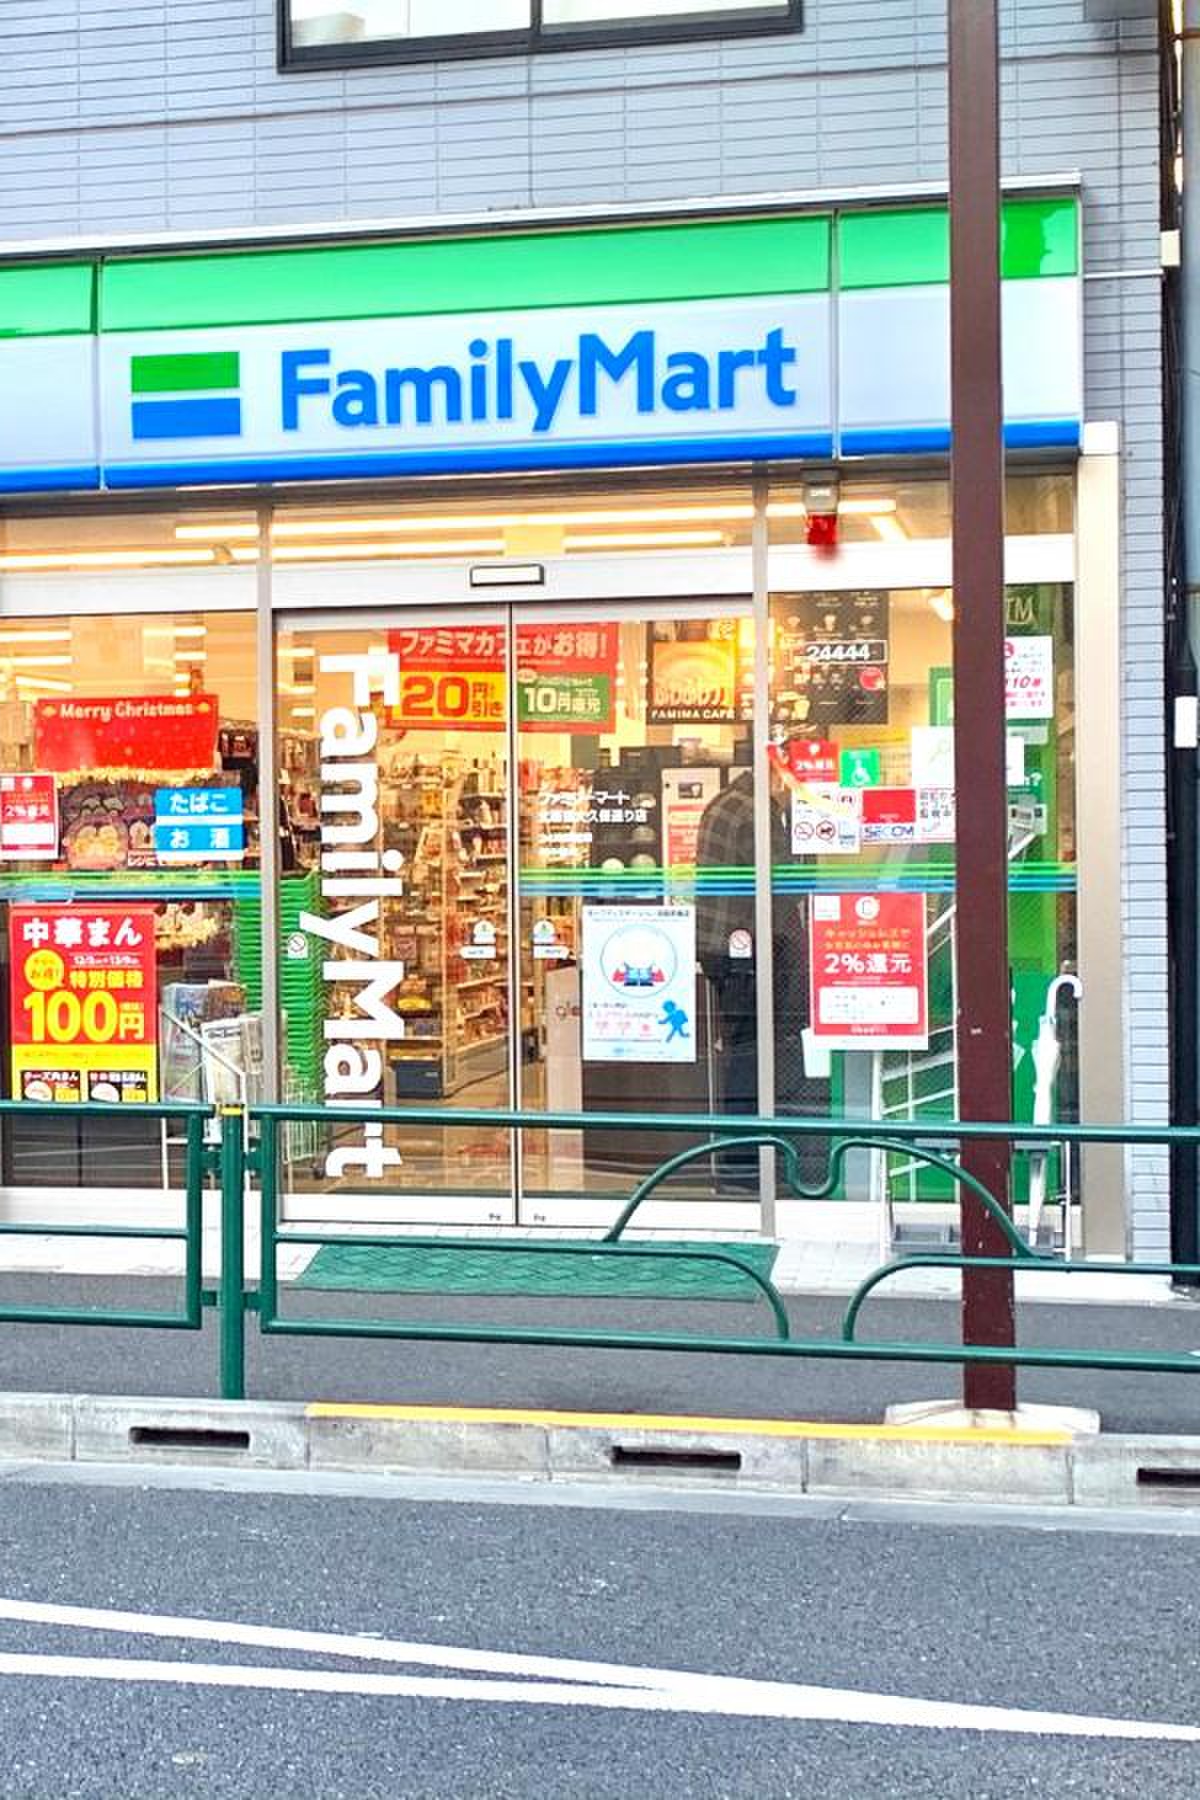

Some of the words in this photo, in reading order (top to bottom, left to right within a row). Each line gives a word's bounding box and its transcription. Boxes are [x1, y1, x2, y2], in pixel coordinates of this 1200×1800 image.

[281, 327, 797, 432] FamilyMart
[402, 676, 469, 717] 20
[61, 703, 112, 723] Merry
[115, 701, 193, 717] Christmas
[651, 709, 700, 719] FAMIMA
[169, 792, 229, 813] たばこ
[169, 827, 230, 849] お酒
[23, 917, 143, 948] 中華まん
[823, 952, 912, 973] 2%還元
[23, 990, 145, 1042] 100円
